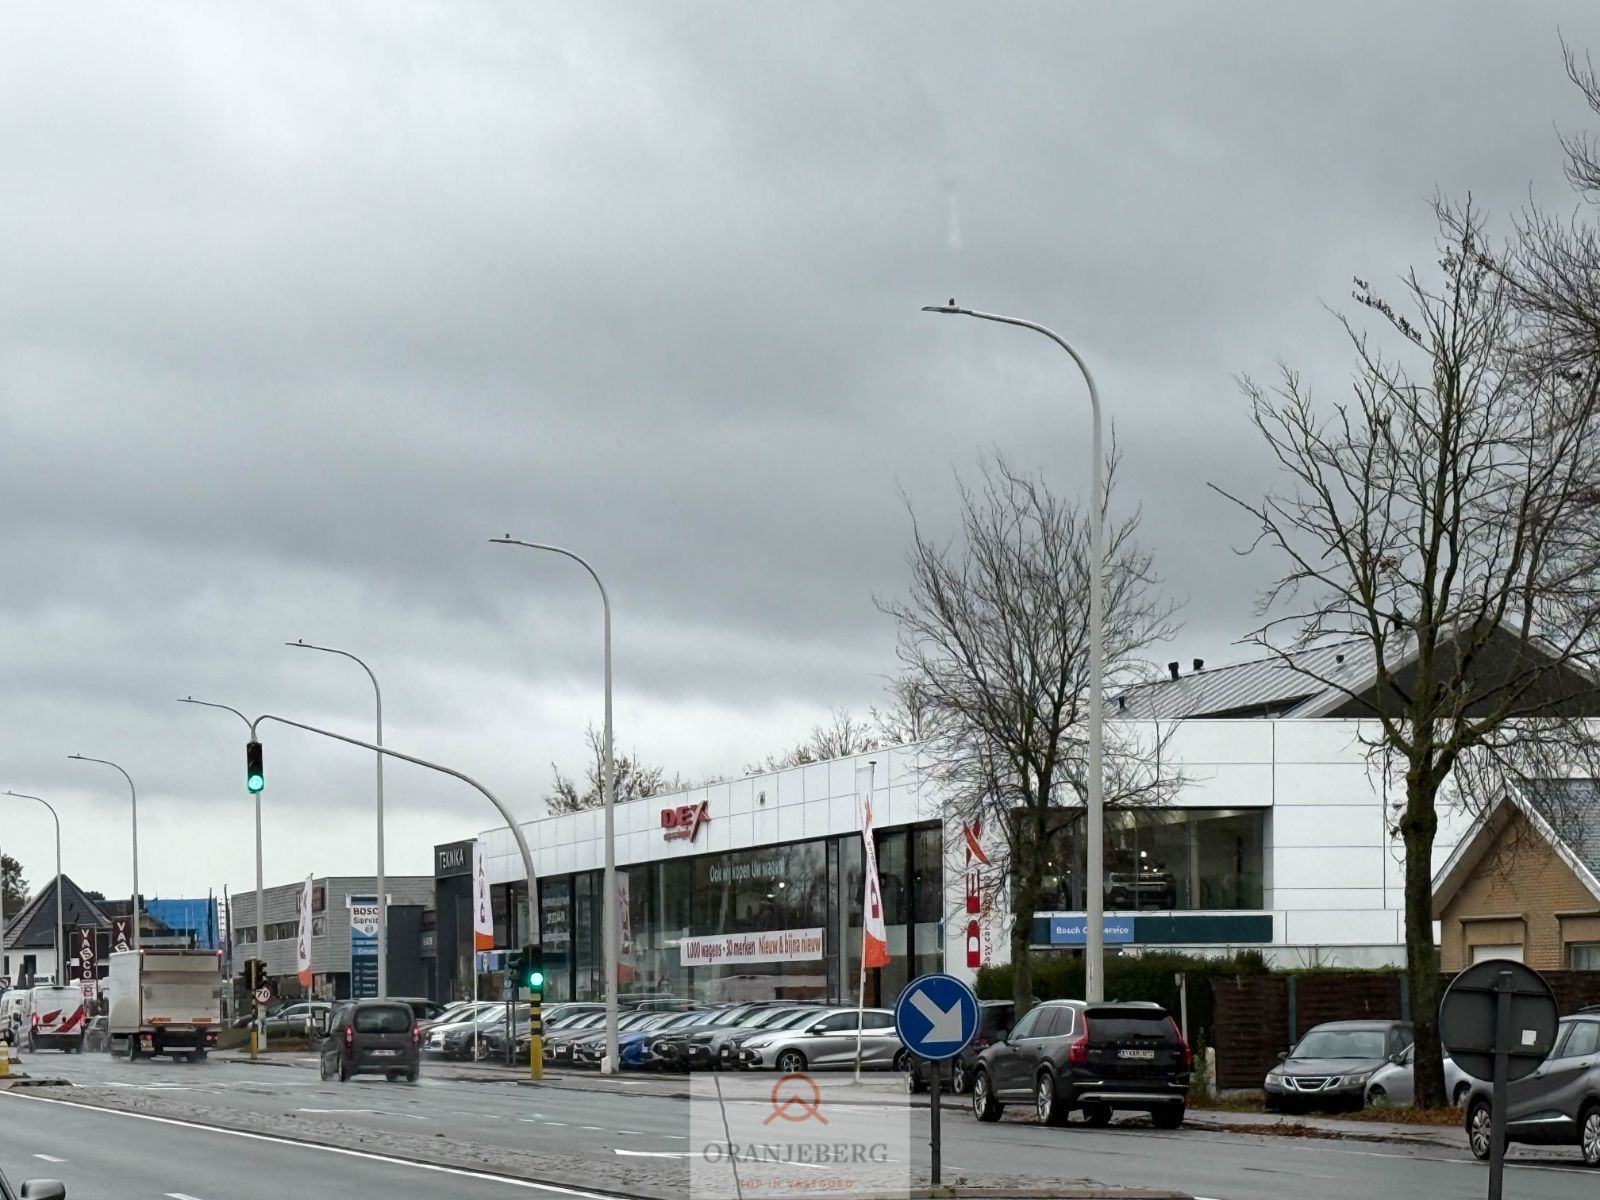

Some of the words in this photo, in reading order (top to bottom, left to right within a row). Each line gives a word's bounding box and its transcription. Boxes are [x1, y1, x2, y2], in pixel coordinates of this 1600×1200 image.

[661, 800, 711, 843] DEX
[963, 819, 992, 968] DEX
[353, 907, 379, 916] BOSC
[1103, 925, 1129, 934] ervice
[80, 929, 93, 979] VASCO
[701, 943, 722, 962] wagens
[733, 936, 756, 956] merken
[759, 935, 778, 955] Nieuw
[784, 932, 800, 959] bijna
[256, 990, 269, 999] 70
